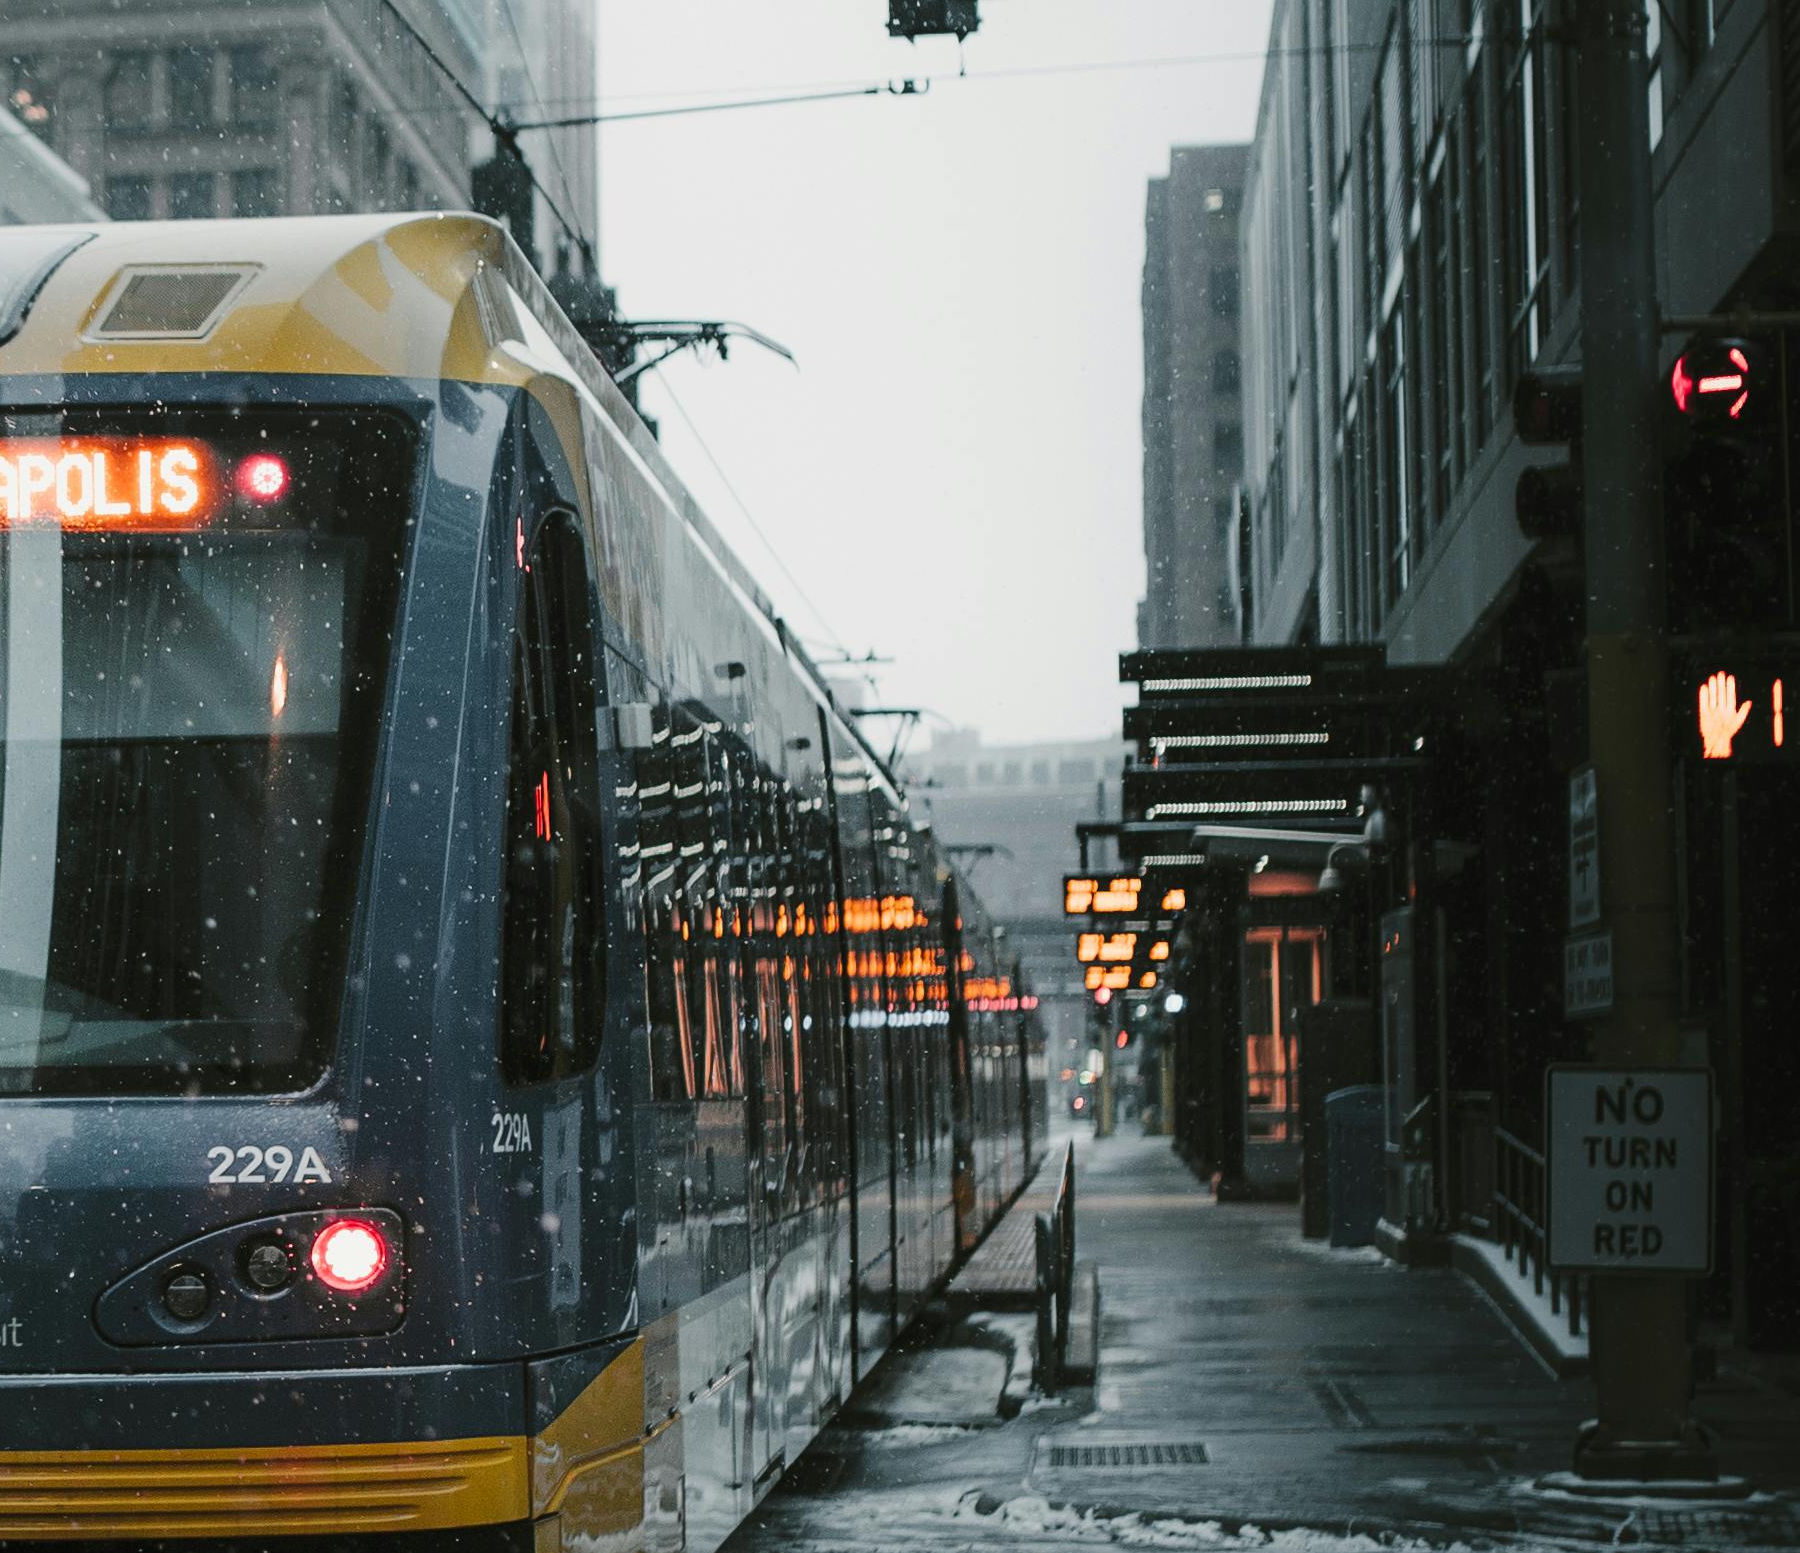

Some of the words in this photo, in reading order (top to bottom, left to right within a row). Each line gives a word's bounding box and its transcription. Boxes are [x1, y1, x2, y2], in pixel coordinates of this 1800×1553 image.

[1594, 1084, 1665, 1125] NO
[491, 1113, 532, 1153] 229A
[207, 1146, 332, 1184] 229A
[1583, 1136, 1677, 1169] TURN
[1605, 1179, 1654, 1213] ON
[1593, 1222, 1664, 1257] RED
